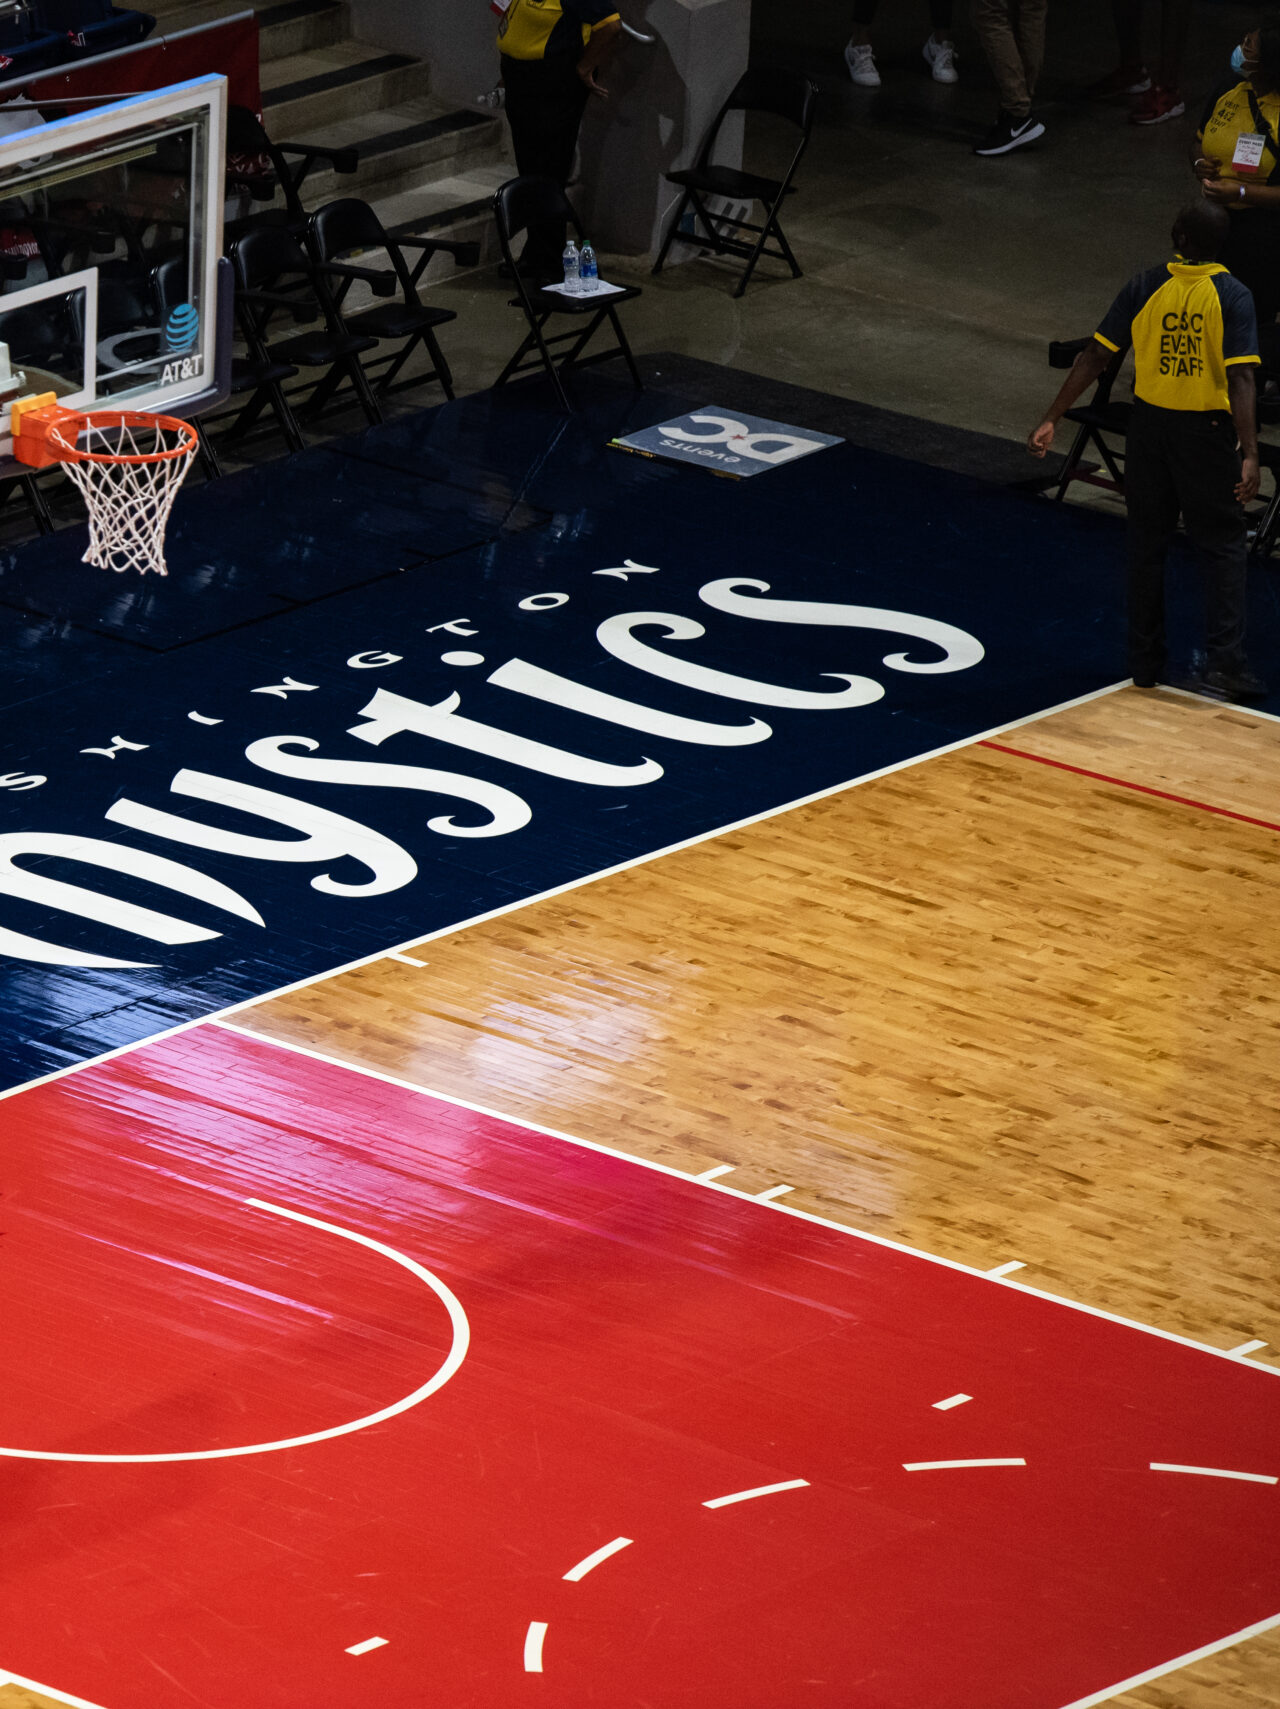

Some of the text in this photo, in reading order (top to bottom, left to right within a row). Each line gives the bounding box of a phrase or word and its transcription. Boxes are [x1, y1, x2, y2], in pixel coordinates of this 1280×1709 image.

[1162, 311, 1203, 333] CSC
[1160, 334, 1202, 356] EVENT
[160, 354, 202, 386] AT&T
[1160, 356, 1204, 377] STAFF
[660, 439, 741, 463] events
